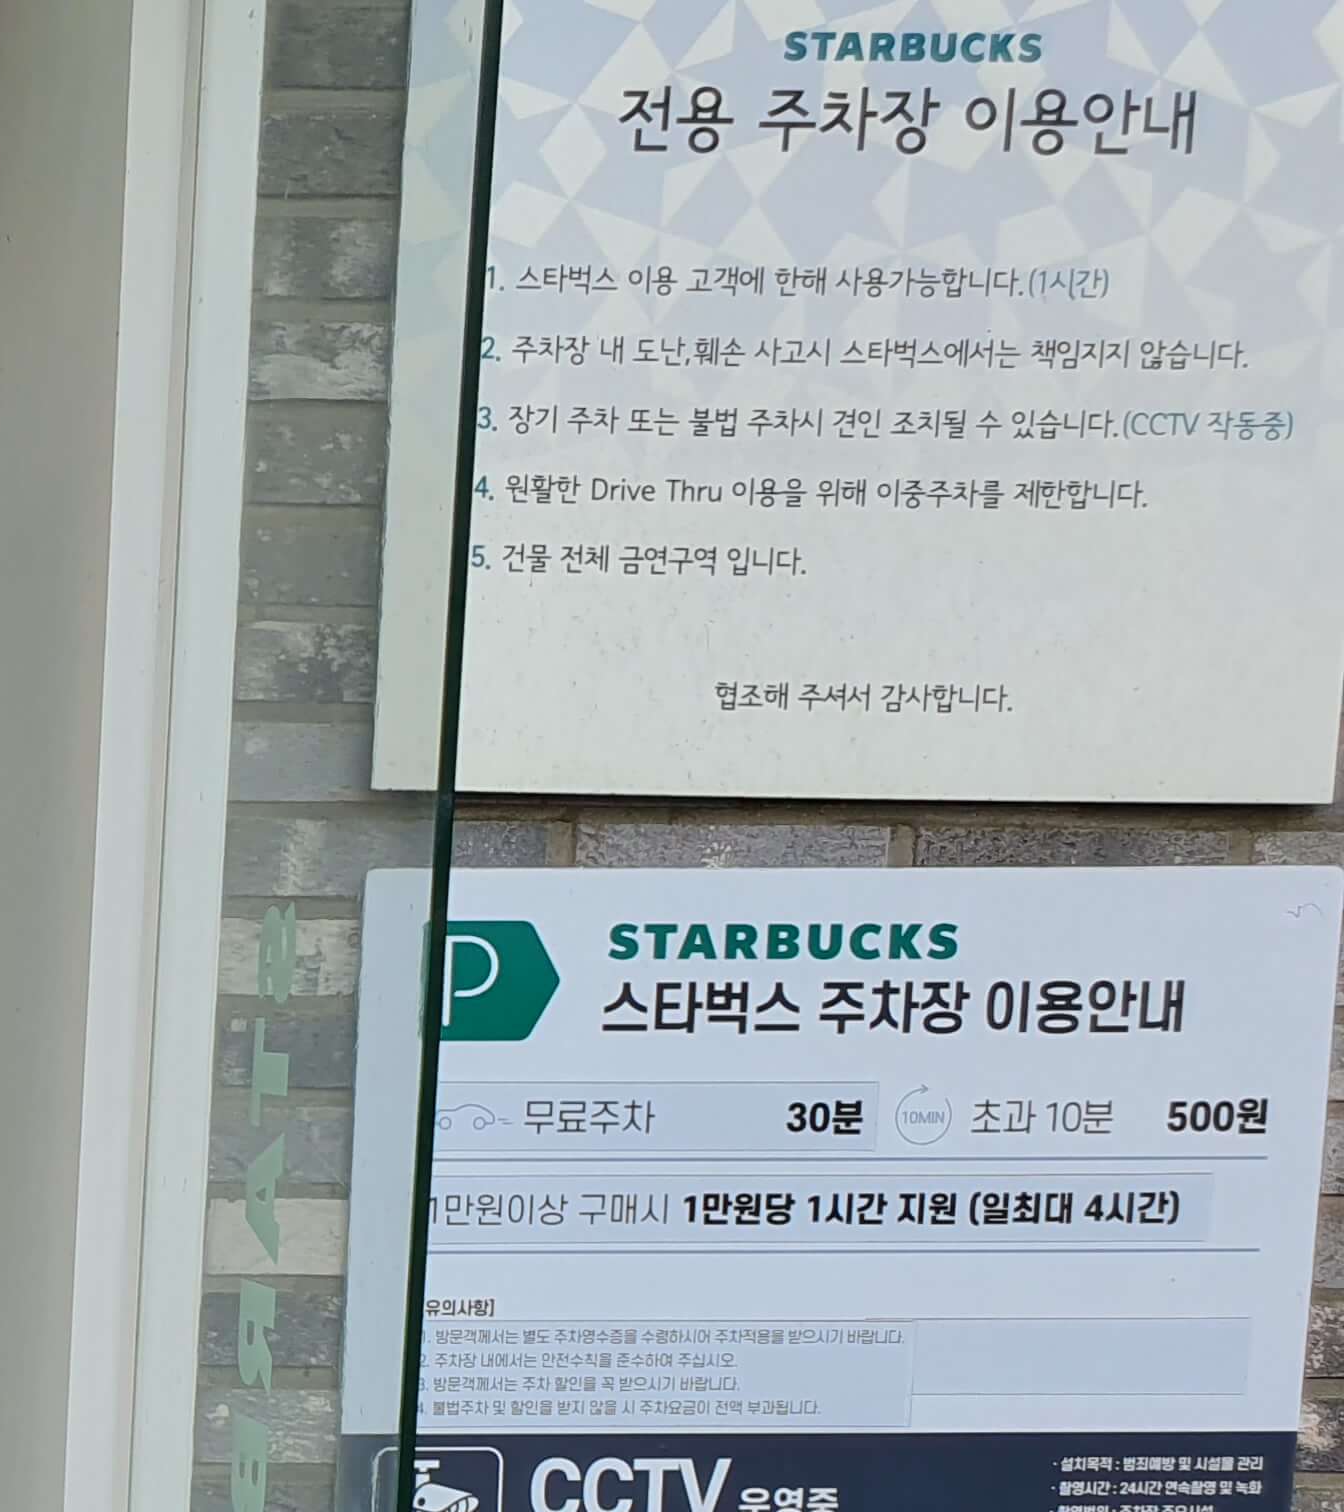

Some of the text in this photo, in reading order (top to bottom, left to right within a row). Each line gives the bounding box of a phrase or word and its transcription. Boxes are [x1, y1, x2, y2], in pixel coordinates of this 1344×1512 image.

[784, 31, 1042, 63] STARBUCKS
[619, 86, 1196, 155] 전용 주차장 이용안내
[486, 267, 504, 296] 1.
[516, 264, 618, 295] 스타벅스
[629, 266, 678, 296] 이용
[686, 267, 764, 296] 고객에
[775, 267, 826, 296] 한해
[477, 406, 497, 439] 3.
[509, 405, 557, 434] 장기
[568, 407, 619, 434] 주차
[628, 408, 680, 436] 또는
[689, 408, 737, 437] 불법
[747, 408, 822, 437] 주차시
[833, 409, 880, 438] 견인
[890, 410, 966, 439] 조치될
[976, 411, 1002, 438] 수
[1208, 411, 1293, 441] 작동중)
[474, 475, 1147, 509] 4. 원활한 Drive Thru 이용을 위해 이중주차를 제한합니다.
[471, 544, 806, 576] 5. 건물 전체 금연구역 입니다.
[715, 682, 1012, 713] 협조해 주셔서 감사합니다.
[608, 923, 958, 960] STARBUCKS
[442, 935, 499, 1026] P
[603, 980, 1184, 1034] 스타벅스 주차장 이용안내
[525, 1100, 863, 1134] 무료주차 30분
[903, 1112, 944, 1123] 10MIN
[971, 1099, 1268, 1134] 초과 10분 500원
[579, 1194, 668, 1224] 구매시
[684, 1193, 795, 1225] 1만원당
[808, 1193, 888, 1224] 1시간
[898, 1193, 956, 1224] 지원
[970, 1192, 1073, 1226] (일최대
[1084, 1191, 1179, 1224] 4시간)
